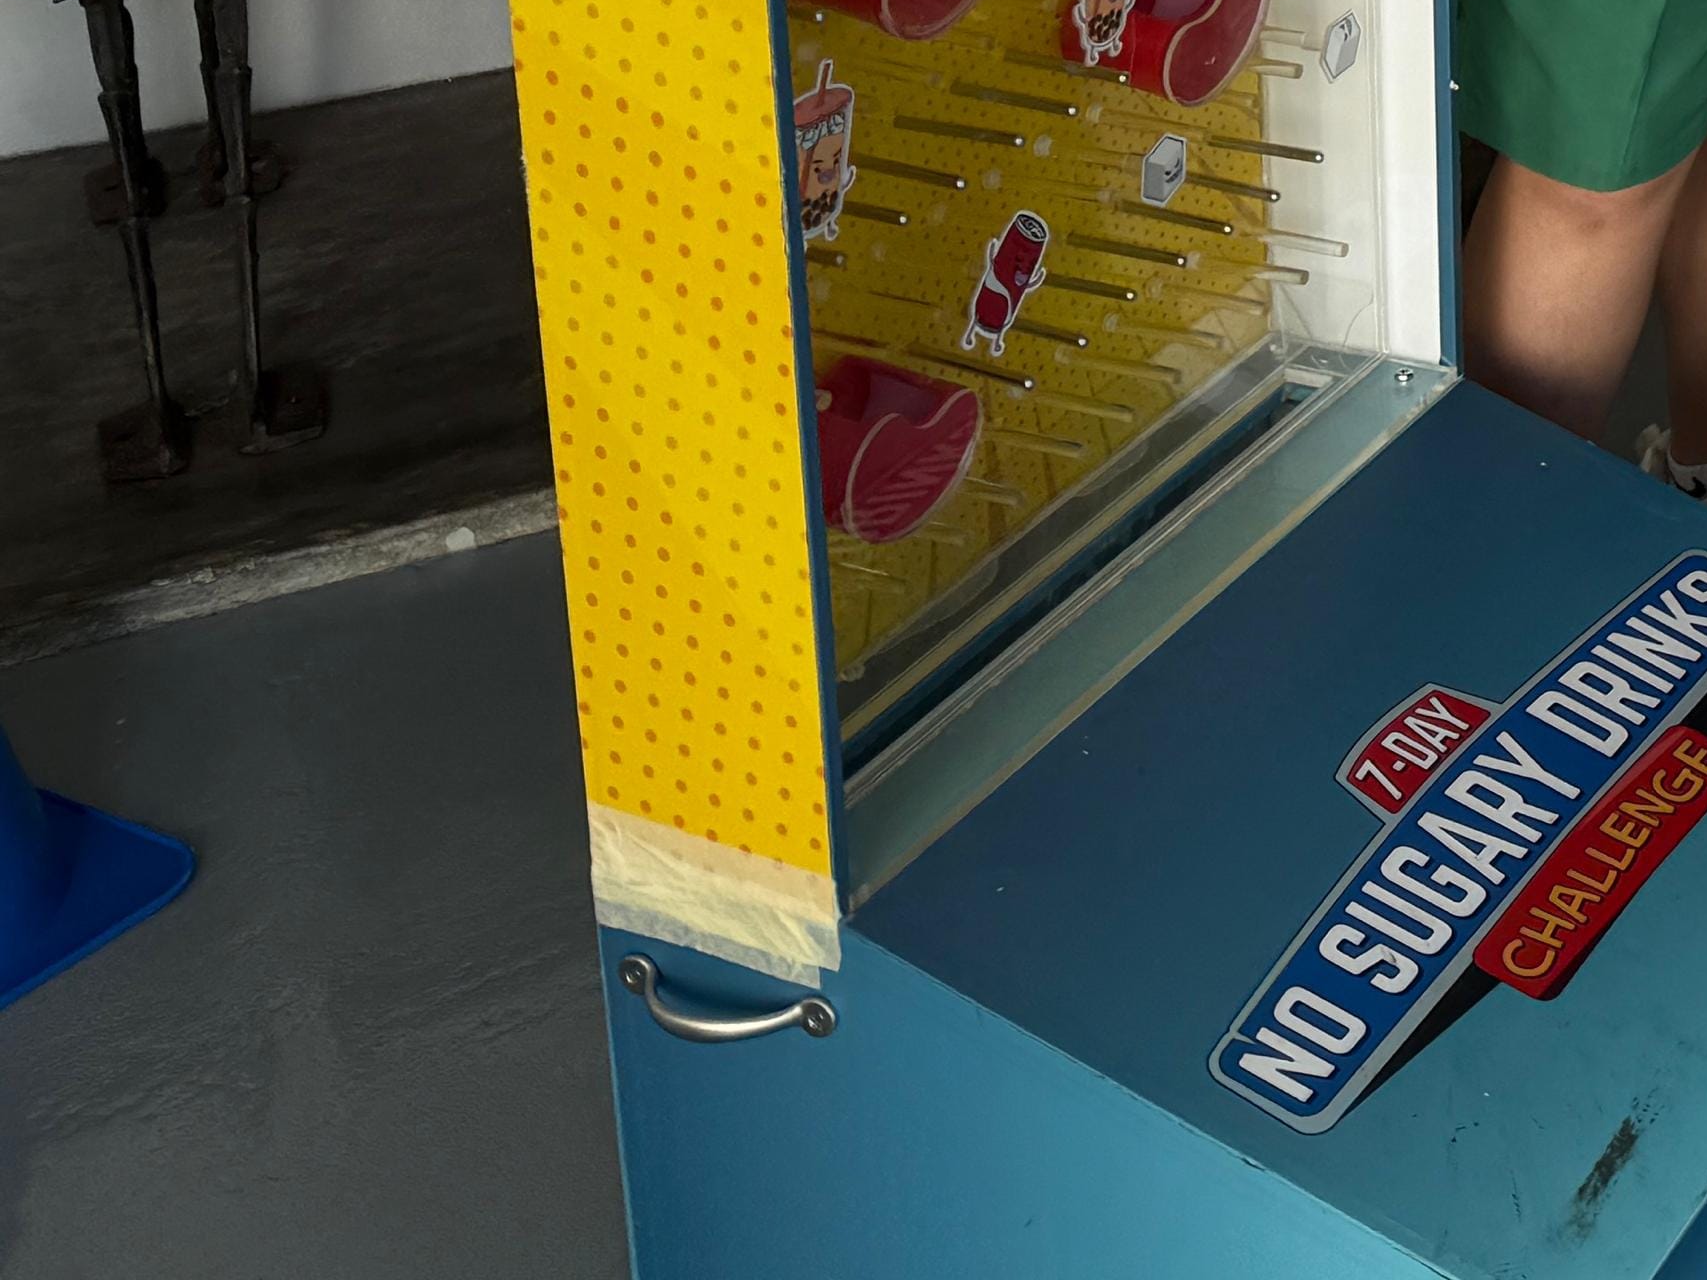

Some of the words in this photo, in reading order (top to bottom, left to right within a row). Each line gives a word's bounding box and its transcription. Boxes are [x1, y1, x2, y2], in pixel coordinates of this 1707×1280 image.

[1355, 693, 1471, 801] 7-DAY
[1238, 985, 1368, 1104] NO
[1318, 730, 1582, 995] SUGARY
